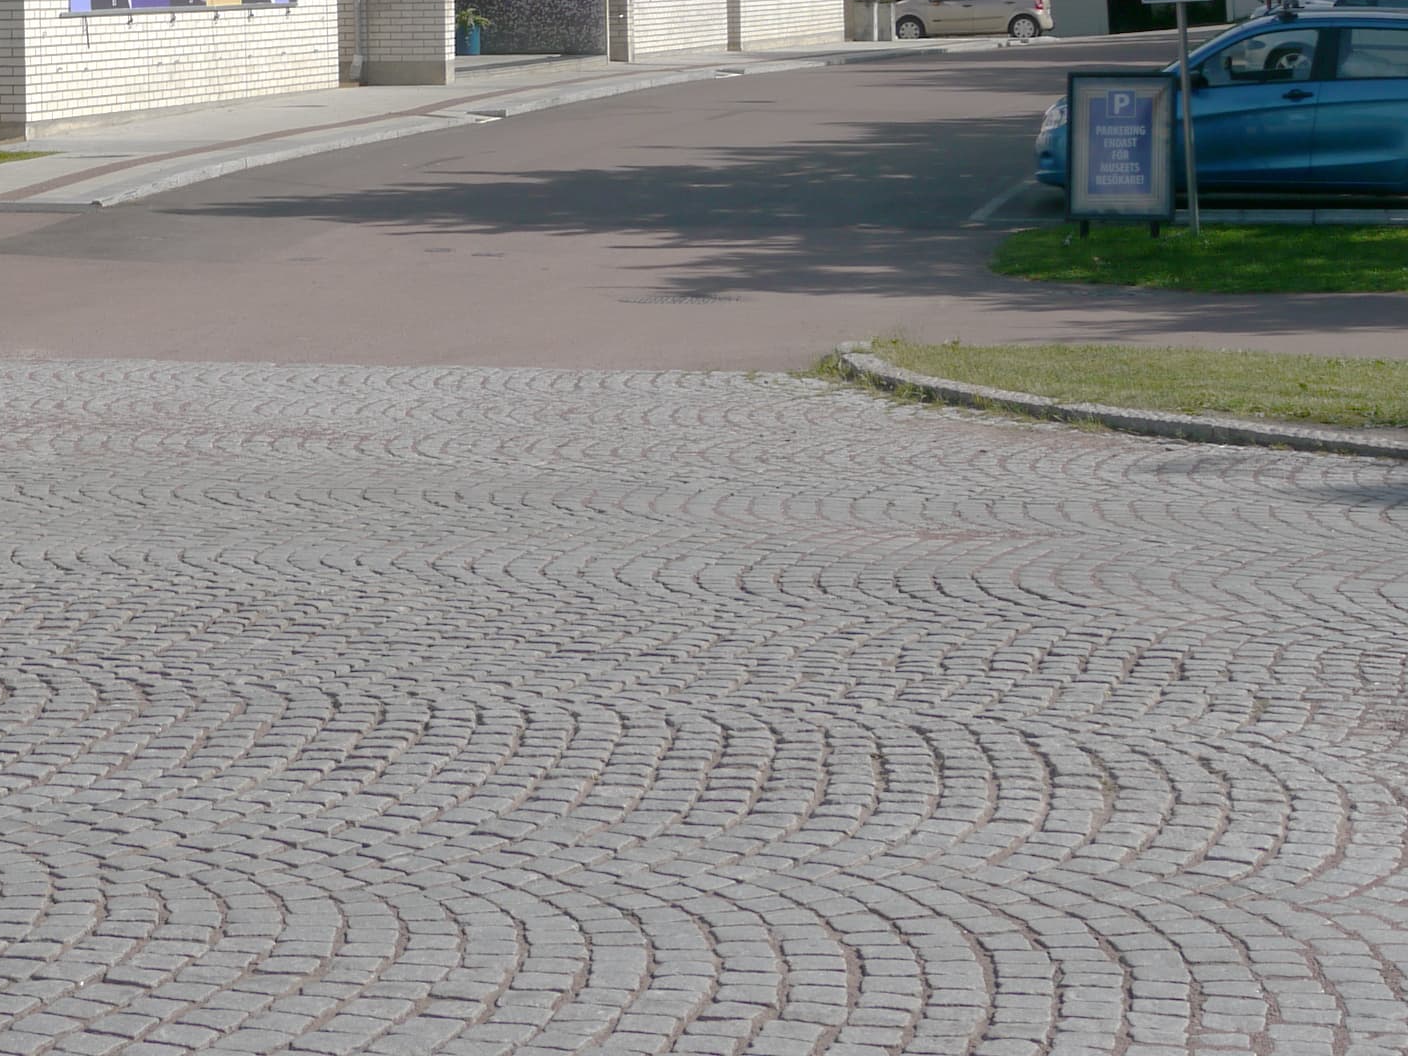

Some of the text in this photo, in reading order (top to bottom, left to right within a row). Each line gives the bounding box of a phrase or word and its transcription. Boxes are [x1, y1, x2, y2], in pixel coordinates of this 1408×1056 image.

[1113, 93, 1130, 115] P
[1095, 125, 1146, 137] PARKERING
[1103, 137, 1137, 148] ENDAST
[1100, 161, 1140, 174] MUSEETS
